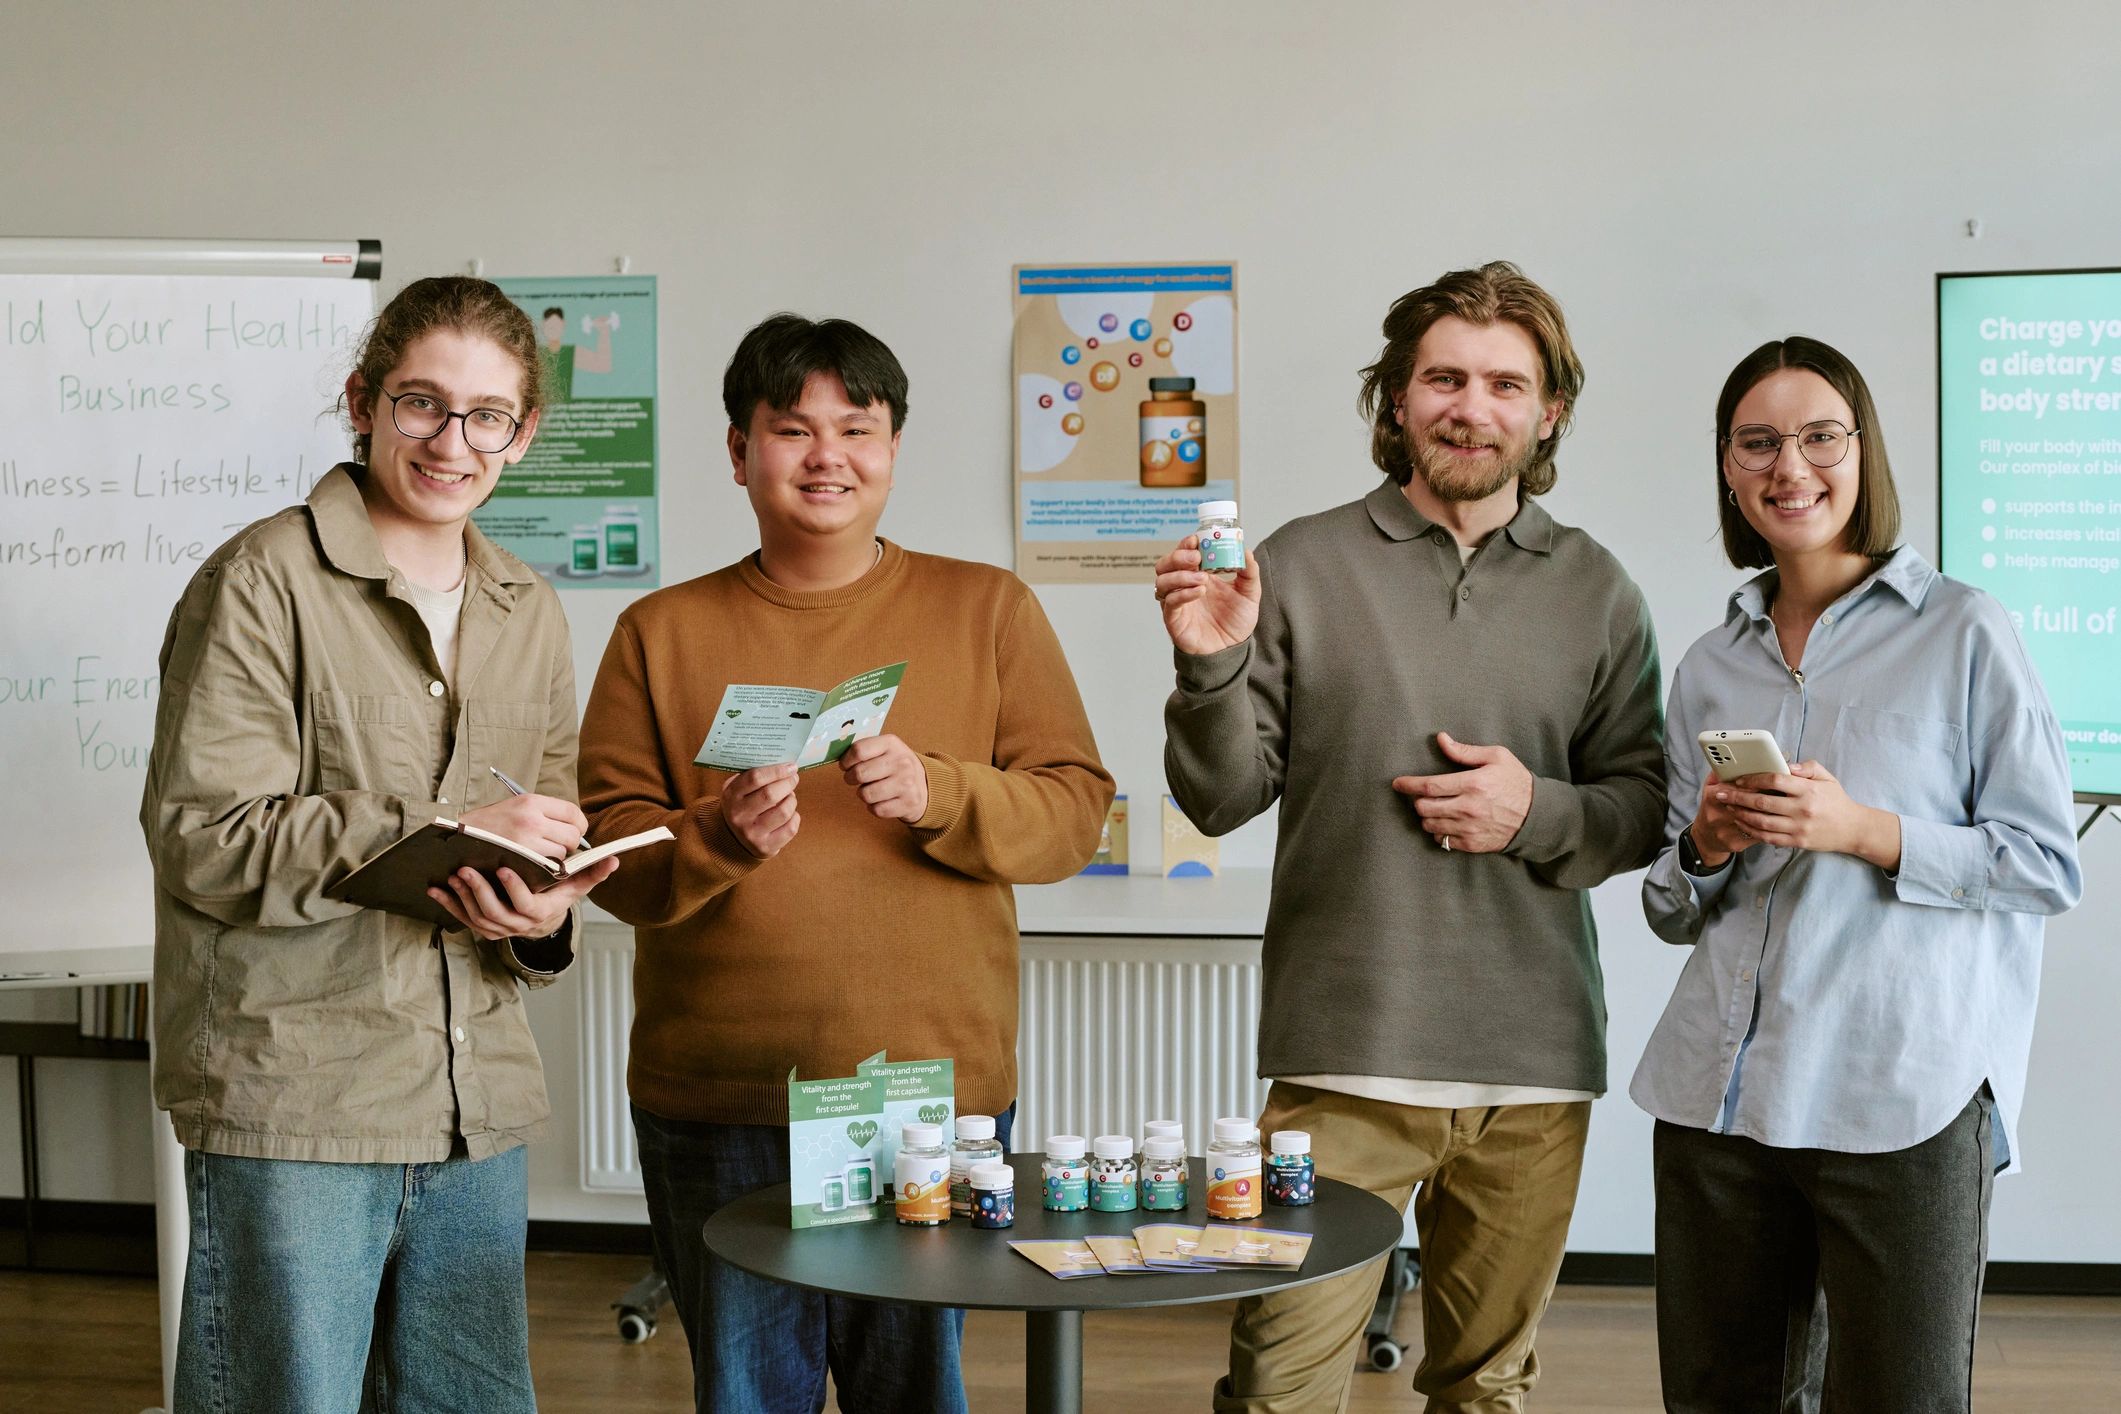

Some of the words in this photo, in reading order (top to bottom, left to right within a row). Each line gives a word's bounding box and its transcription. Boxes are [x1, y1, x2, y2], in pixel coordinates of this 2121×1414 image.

[8, 299, 46, 345] ld
[76, 298, 173, 358] Your
[205, 298, 350, 351] Health
[1979, 316, 2084, 347] Charge
[2087, 319, 2121, 347] yo
[1979, 357, 1998, 376] a
[2002, 350, 2106, 382] dietary
[60, 374, 232, 413] Business
[1979, 387, 2050, 420] body
[1980, 439, 2001, 453] Fill
[2004, 441, 2039, 457] your
[2043, 440, 2083, 457] body
[2, 459, 91, 498] llness
[134, 453, 268, 499] Lifestyle
[1980, 460, 2008, 473] Our
[2012, 461, 2080, 478] complex
[2084, 460, 2100, 474] of
[2004, 501, 2075, 517] supports
[2079, 500, 2105, 514] the
[2004, 525, 2081, 541] increases
[2004, 553, 2048, 571] helps
[2053, 556, 2119, 574] manage
[2033, 604, 2078, 633] full
[2086, 607, 2116, 634] of
[843, 675, 868, 689] Achieve
[867, 670, 886, 680] more
[844, 684, 859, 693] with
[870, 1068, 896, 1077] Vitality
[896, 1066, 911, 1075] and
[911, 1064, 942, 1075] strength
[801, 1085, 826, 1094] Vitality
[827, 1083, 841, 1092] and
[842, 1080, 872, 1091] strength
[891, 1077, 908, 1086] from
[909, 1076, 922, 1084] the
[821, 1094, 839, 1103] from
[839, 1093, 852, 1101] the
[886, 1087, 902, 1097] first
[900, 1085, 930, 1096] capsule!
[815, 1105, 829, 1114] first
[830, 1102, 860, 1113] capsule!
[1239, 1183, 1247, 1192] A
